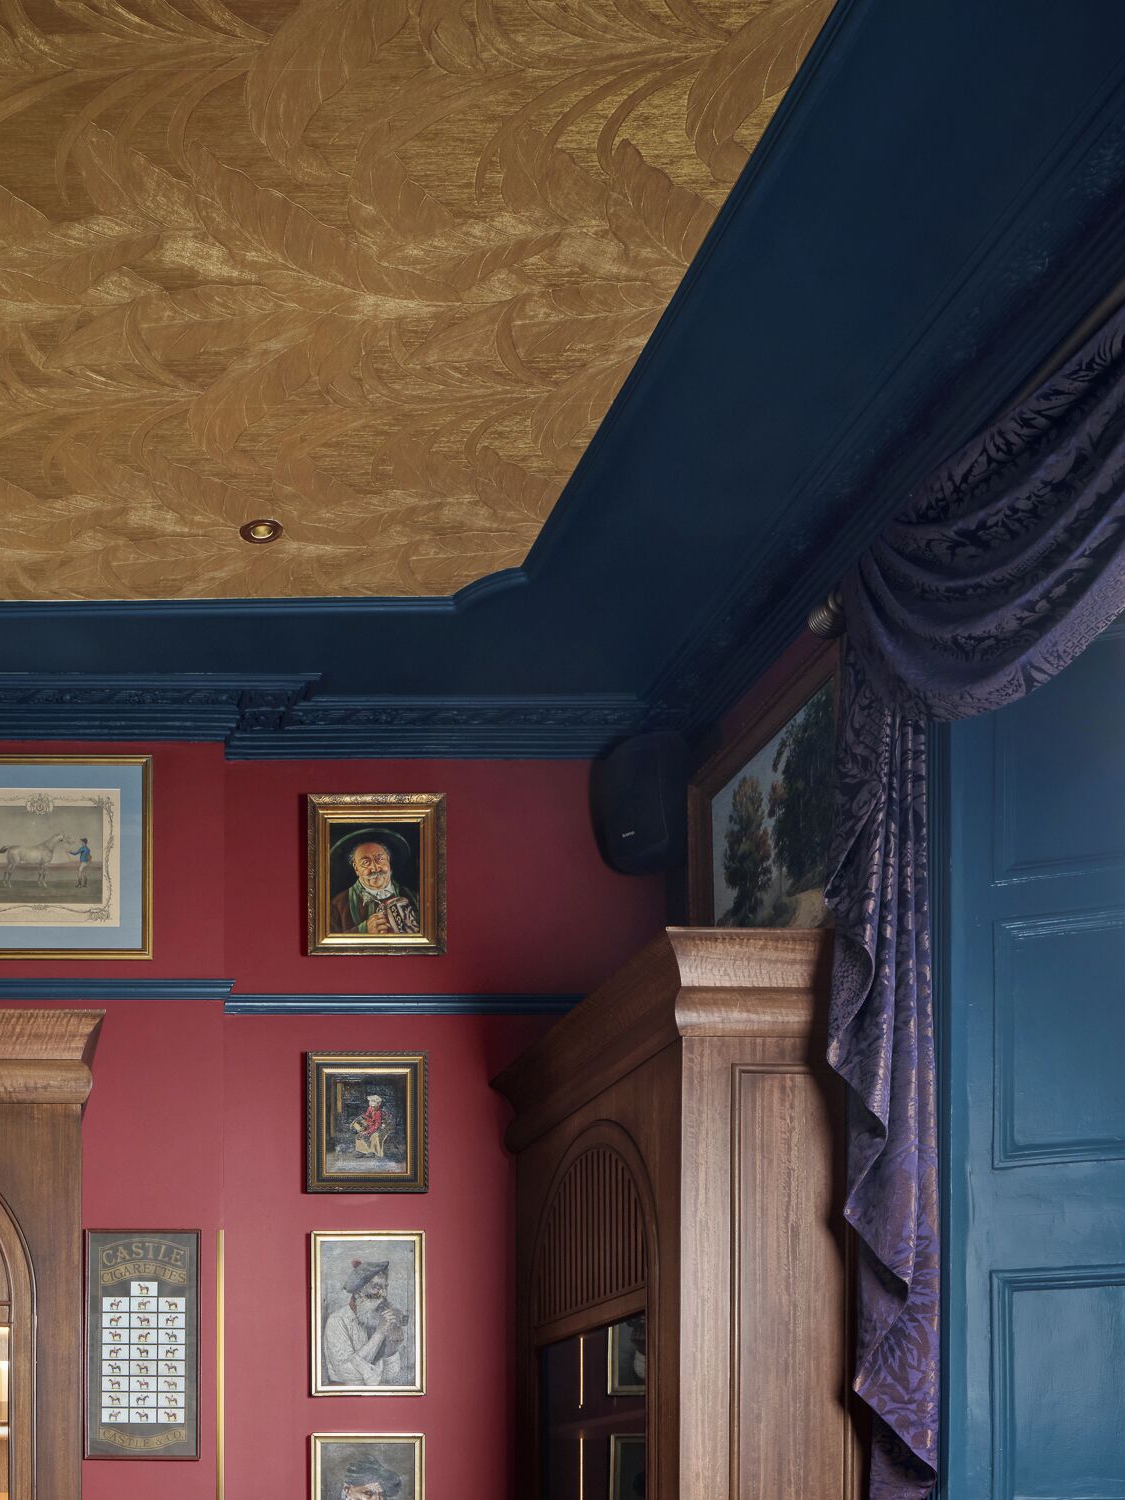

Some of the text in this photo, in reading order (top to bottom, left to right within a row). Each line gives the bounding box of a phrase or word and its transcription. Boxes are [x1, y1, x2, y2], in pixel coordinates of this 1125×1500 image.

[102, 1242, 185, 1266] CASTLE
[101, 1263, 187, 1283] CIGARETTES
[103, 1429, 152, 1448] CASTLE
[155, 1436, 164, 1446] &
